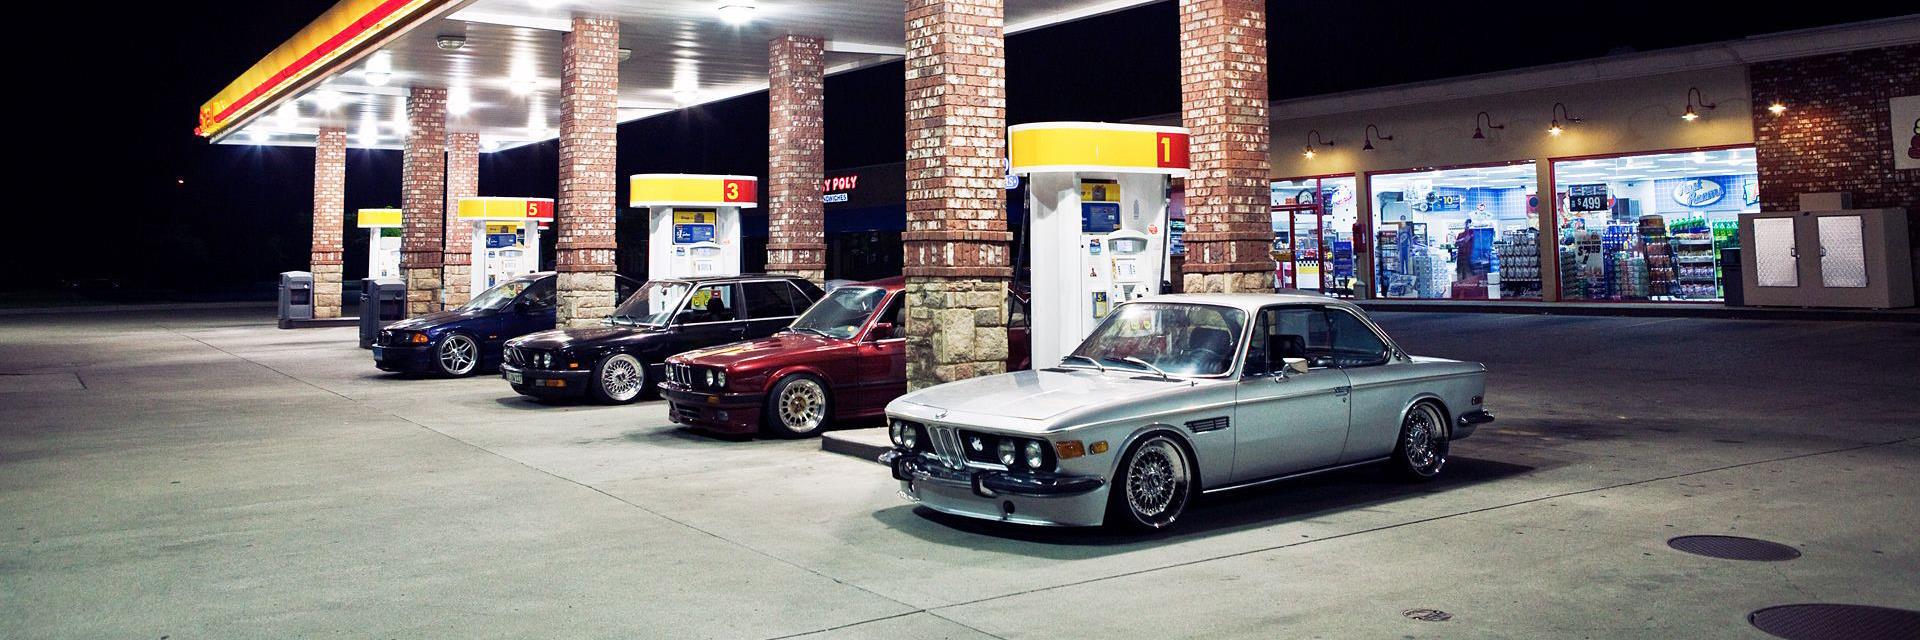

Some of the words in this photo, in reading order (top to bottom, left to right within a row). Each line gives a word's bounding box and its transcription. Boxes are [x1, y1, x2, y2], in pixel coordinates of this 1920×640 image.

[1160, 137, 1171, 163] 1
[726, 182, 739, 200] 3
[832, 175, 858, 191] POLY
[528, 202, 538, 216] 5
